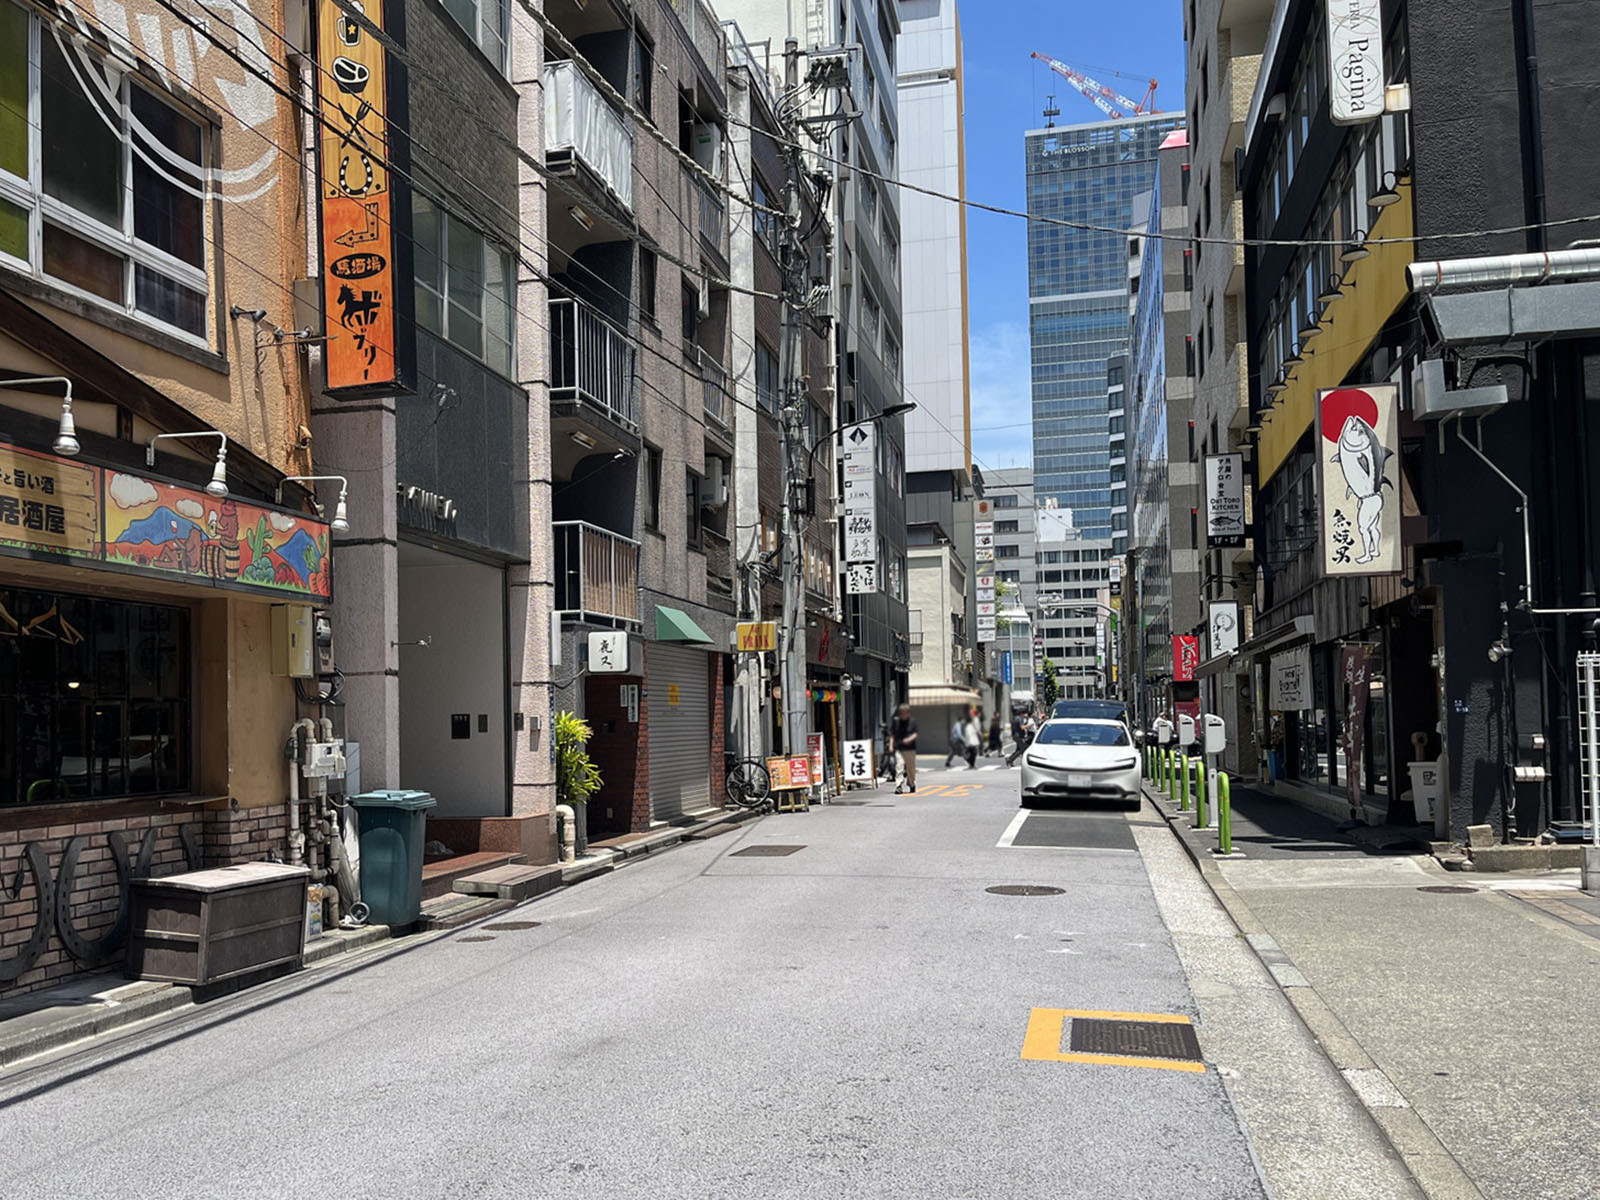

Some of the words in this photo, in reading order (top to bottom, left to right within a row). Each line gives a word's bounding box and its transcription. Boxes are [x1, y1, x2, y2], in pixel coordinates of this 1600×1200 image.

[1349, 1, 1361, 30] ERIA
[1342, 37, 1369, 113] Pagina
[1050, 148, 1063, 156] THE
[1064, 145, 1096, 154] BLOSSOM
[335, 256, 381, 276] 馬酒場
[0, 467, 54, 495] と旨い酒
[0, 495, 65, 535] 居酒屋
[849, 744, 867, 777] そば
